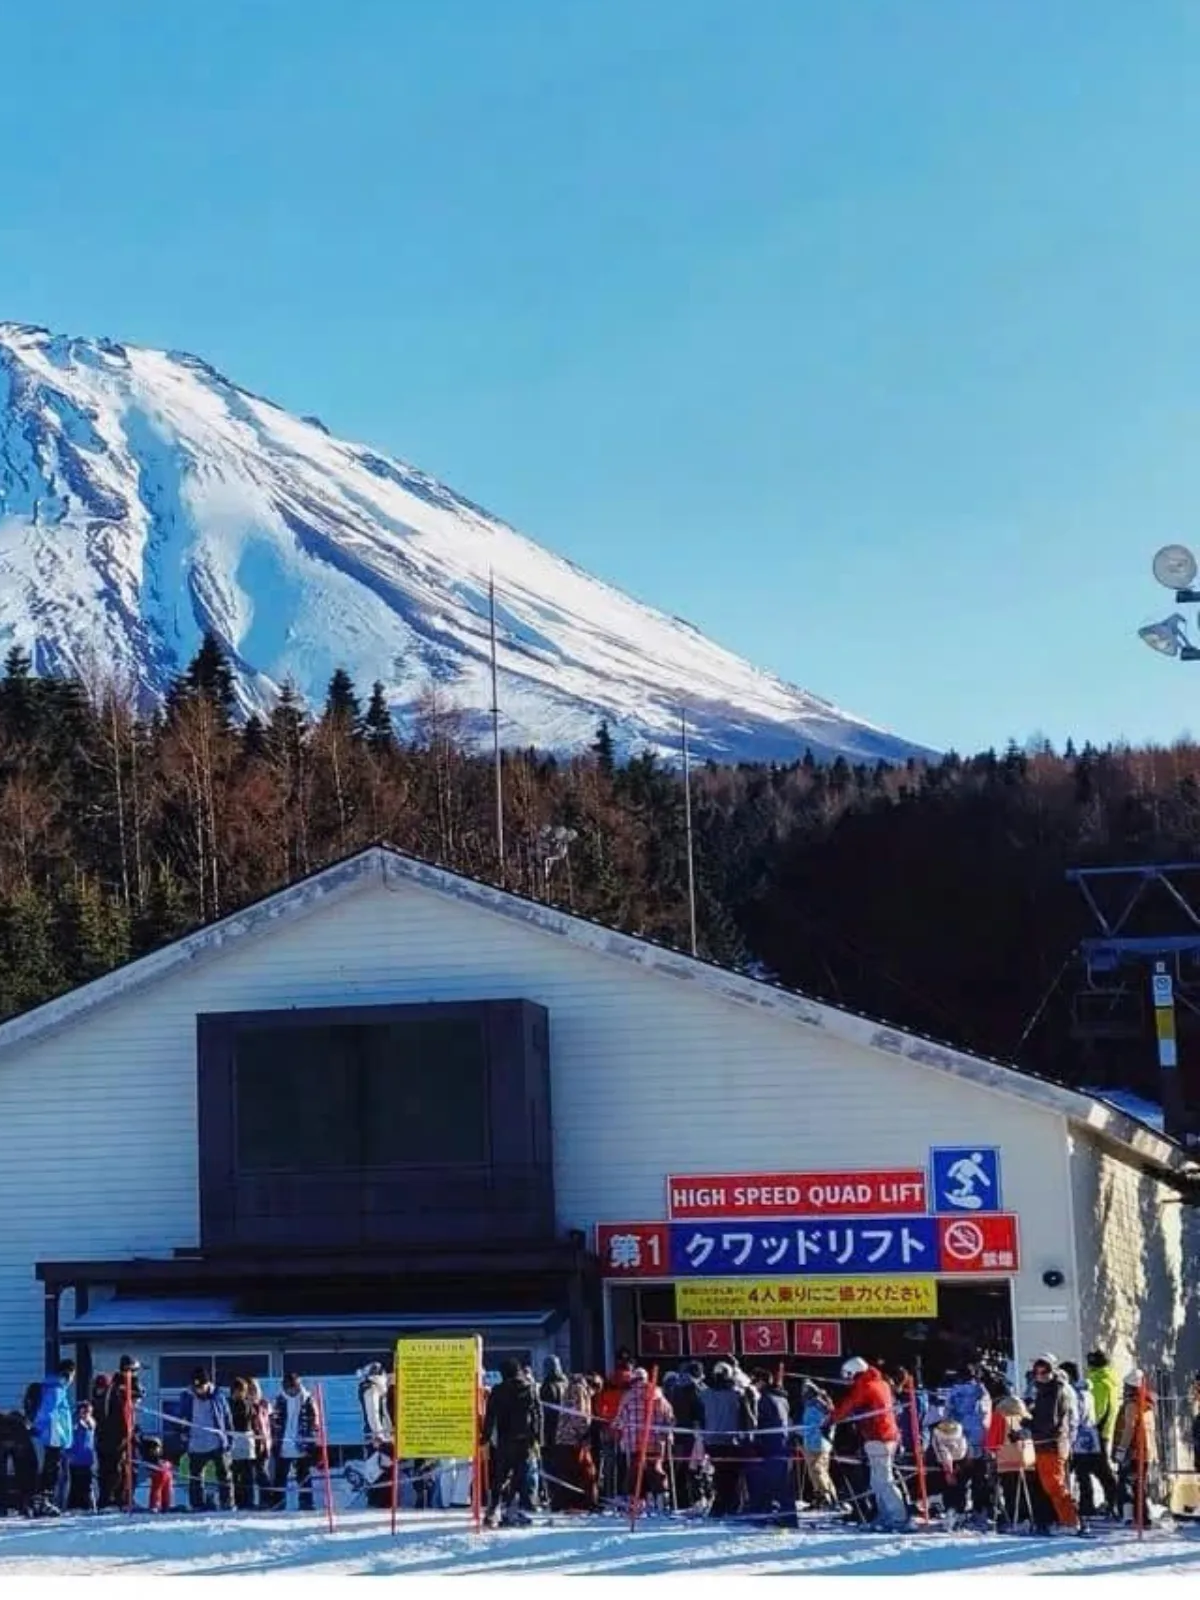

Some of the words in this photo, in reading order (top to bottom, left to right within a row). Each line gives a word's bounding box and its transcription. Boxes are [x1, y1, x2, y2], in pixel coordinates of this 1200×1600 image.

[673, 1188, 726, 1207] HIGH
[734, 1186, 800, 1205] SPEED
[808, 1184, 872, 1207] QUAD
[880, 1183, 923, 1203] LIFT
[609, 1233, 661, 1269] 第1
[686, 1227, 925, 1268] クワッドリフト
[706, 1329, 719, 1348] 2
[758, 1326, 772, 1347] 3
[811, 1328, 824, 1349] 4
